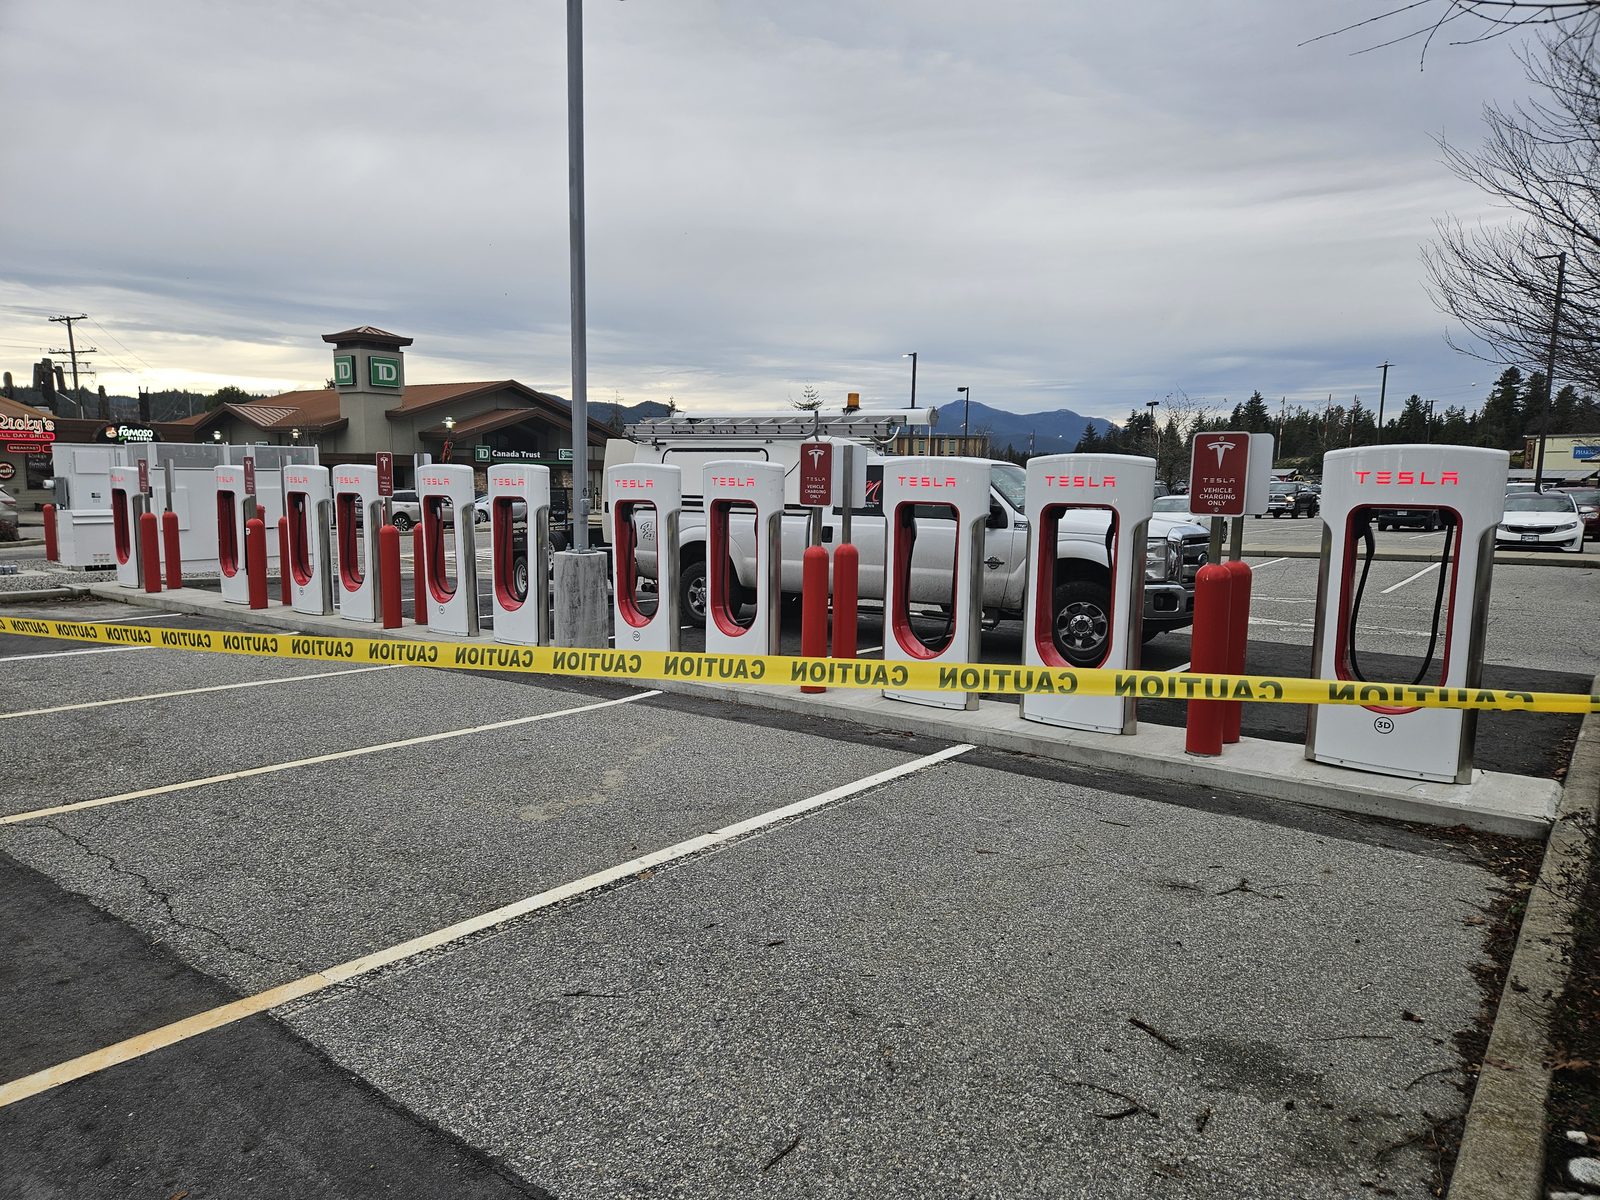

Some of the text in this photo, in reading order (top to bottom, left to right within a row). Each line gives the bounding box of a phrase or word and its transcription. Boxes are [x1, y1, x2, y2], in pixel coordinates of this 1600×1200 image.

[336, 362, 351, 379] TD
[374, 363, 397, 381] TD
[477, 449, 489, 459] TD
[491, 450, 519, 458] Canada
[423, 478, 450, 486] TESLA
[493, 478, 525, 486] TESLA
[712, 477, 755, 487] TESLA
[898, 476, 956, 487] TESLA
[1045, 475, 1117, 488] TESLA
[1354, 470, 1460, 486] TESLA
[615, 479, 653, 488] TESLA
[1377, 721, 1391, 729] 3D
